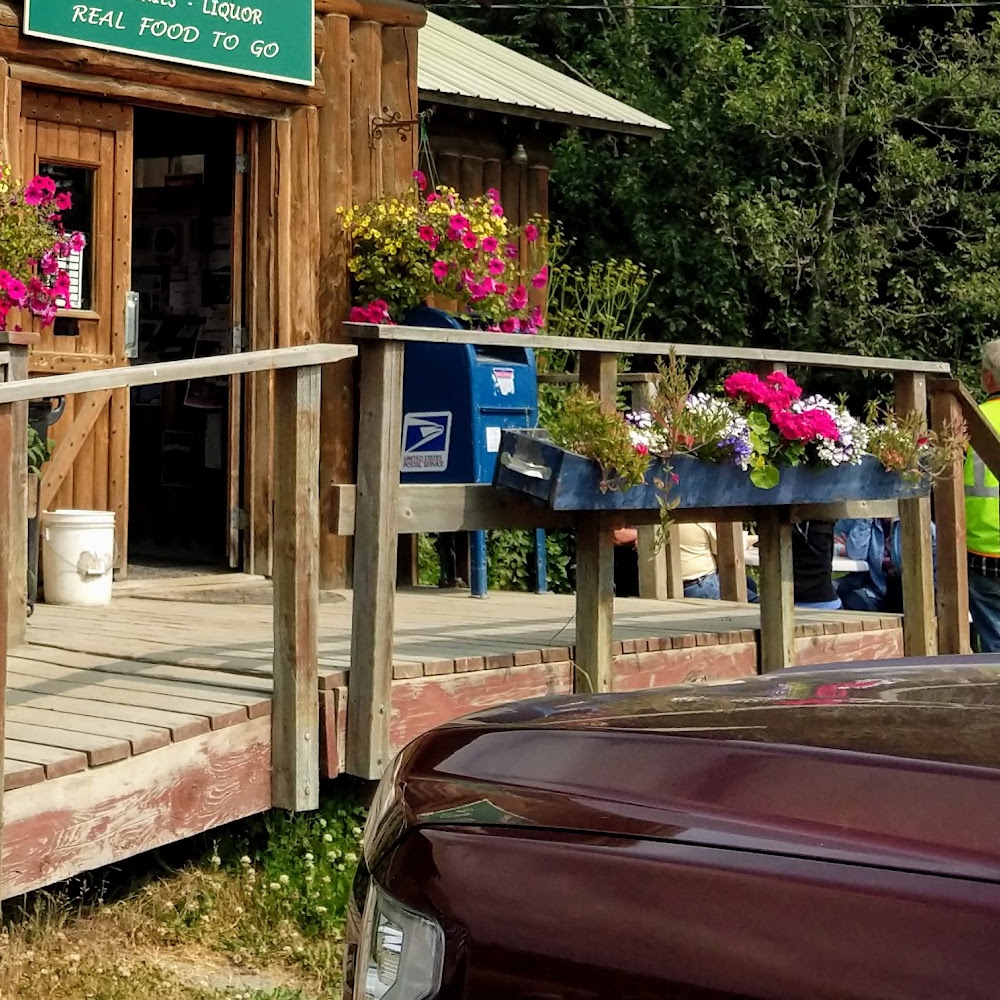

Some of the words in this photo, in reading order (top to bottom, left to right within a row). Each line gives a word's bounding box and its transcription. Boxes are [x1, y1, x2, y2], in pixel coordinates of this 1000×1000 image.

[71, 4, 126, 30] REAL
[138, 16, 200, 43] FOOD
[212, 30, 240, 51] TO
[250, 39, 280, 58] GO
